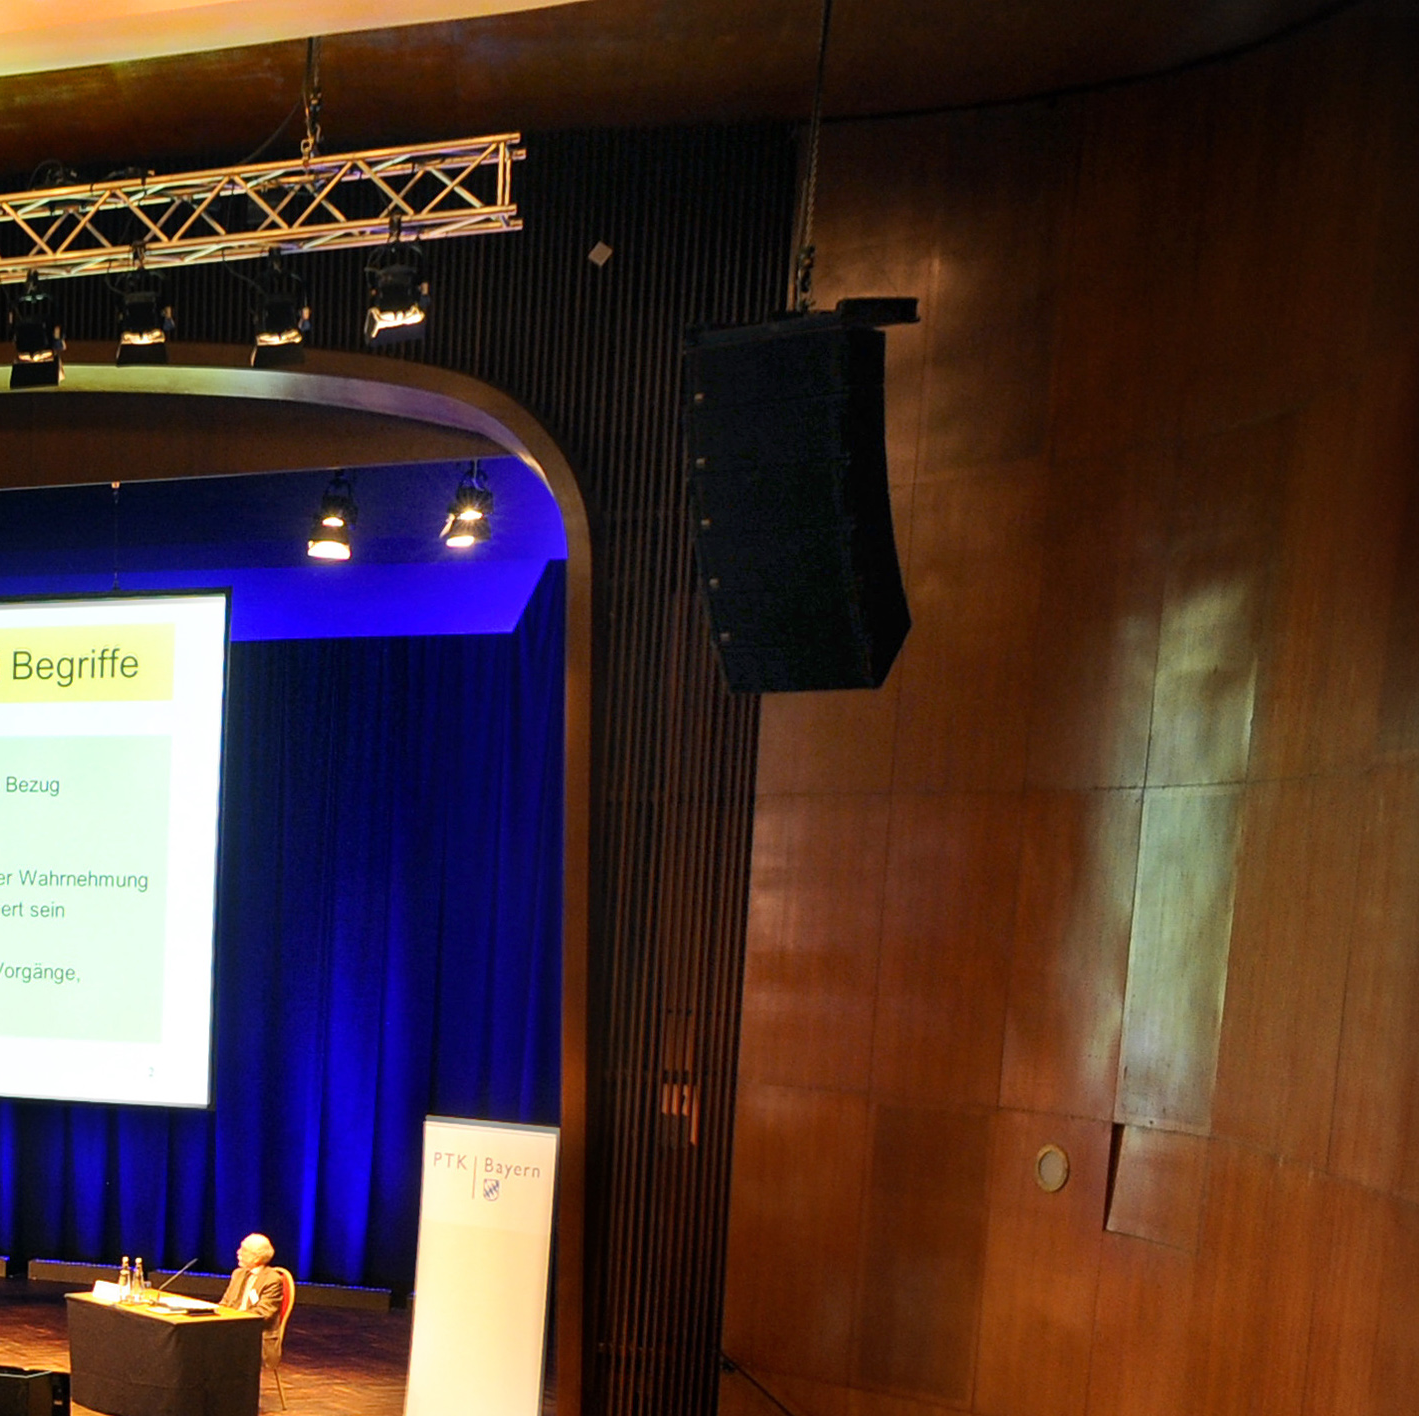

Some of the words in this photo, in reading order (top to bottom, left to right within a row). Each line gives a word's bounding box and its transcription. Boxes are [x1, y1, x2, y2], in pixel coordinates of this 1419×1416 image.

[12, 647, 139, 688] Begriffe
[5, 775, 60, 797] Bezug
[18, 869, 148, 893] Wahrnehmung
[31, 902, 64, 917] sein
[433, 1151, 469, 1171] PTK
[484, 1157, 541, 1179] Bayern
